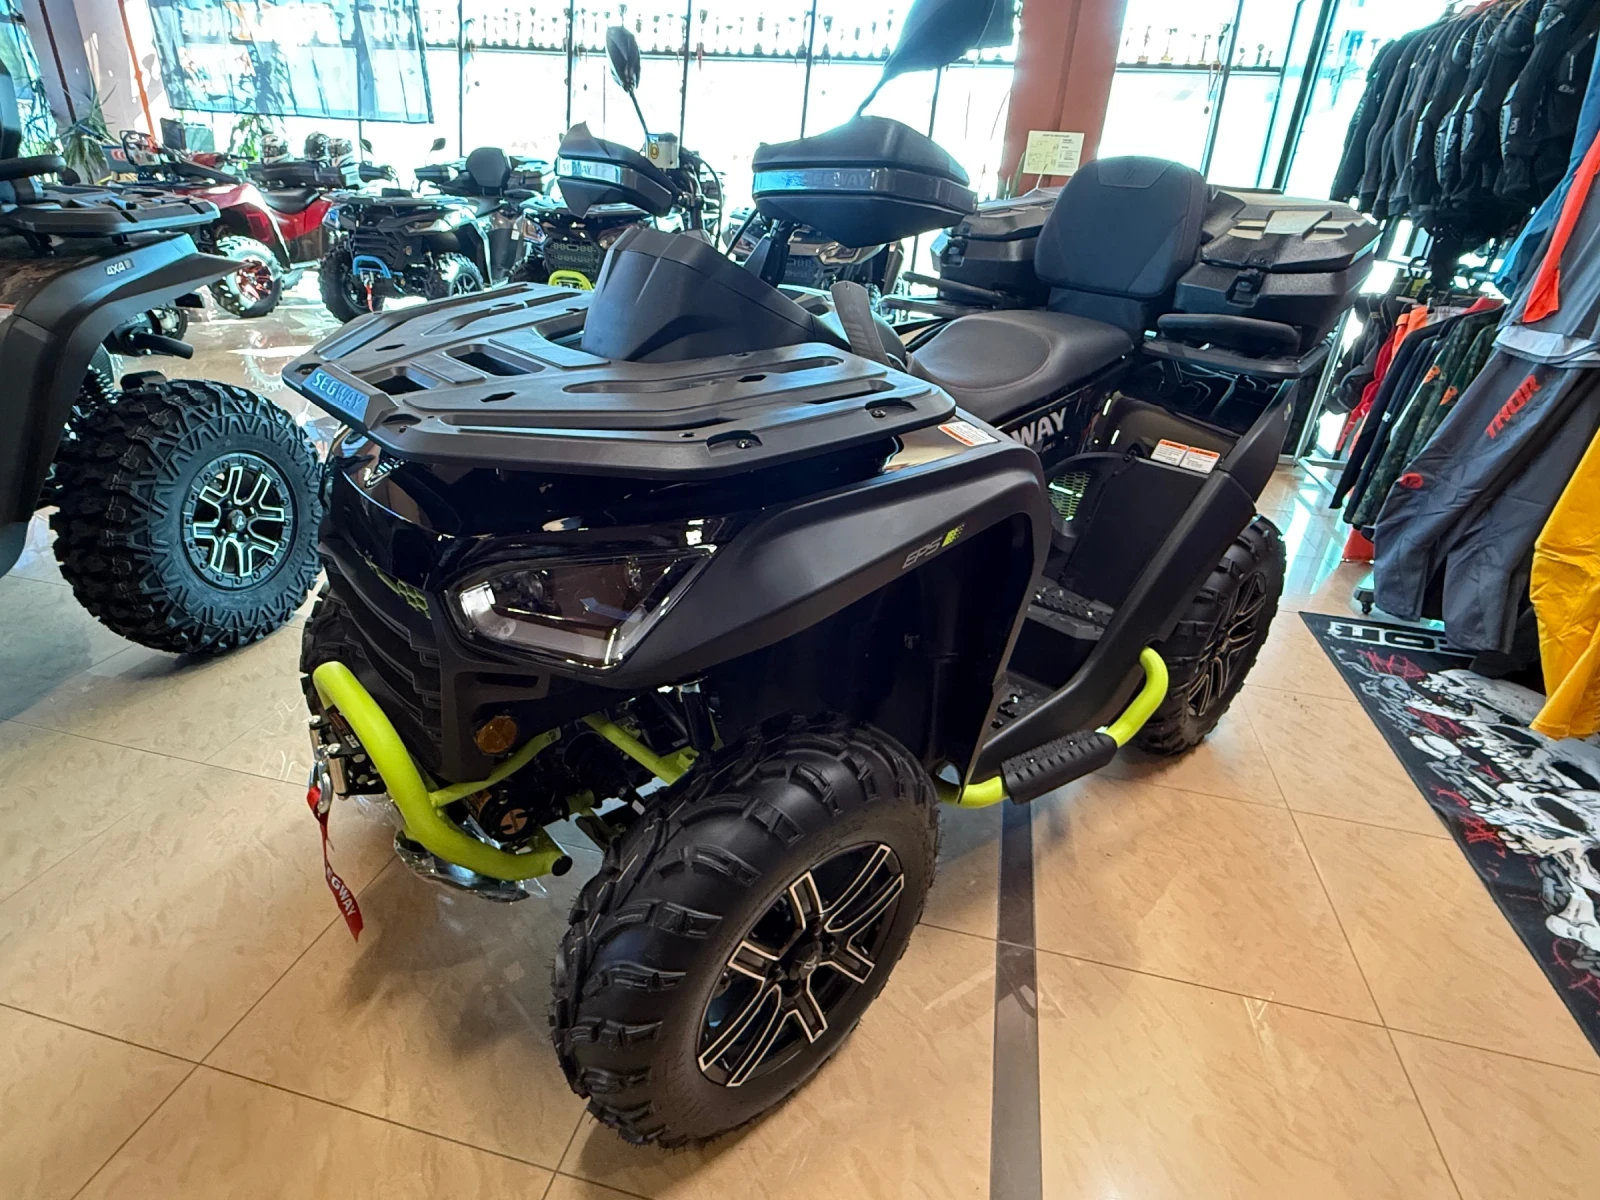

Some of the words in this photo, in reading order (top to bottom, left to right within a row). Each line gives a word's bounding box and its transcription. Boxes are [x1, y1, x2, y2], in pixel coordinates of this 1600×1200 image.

[311, 372, 365, 410] SEGWAY
[1485, 374, 1541, 440] THOR
[1010, 407, 1067, 447] WAY
[902, 536, 943, 570] EPS
[326, 867, 356, 916] GWAY
